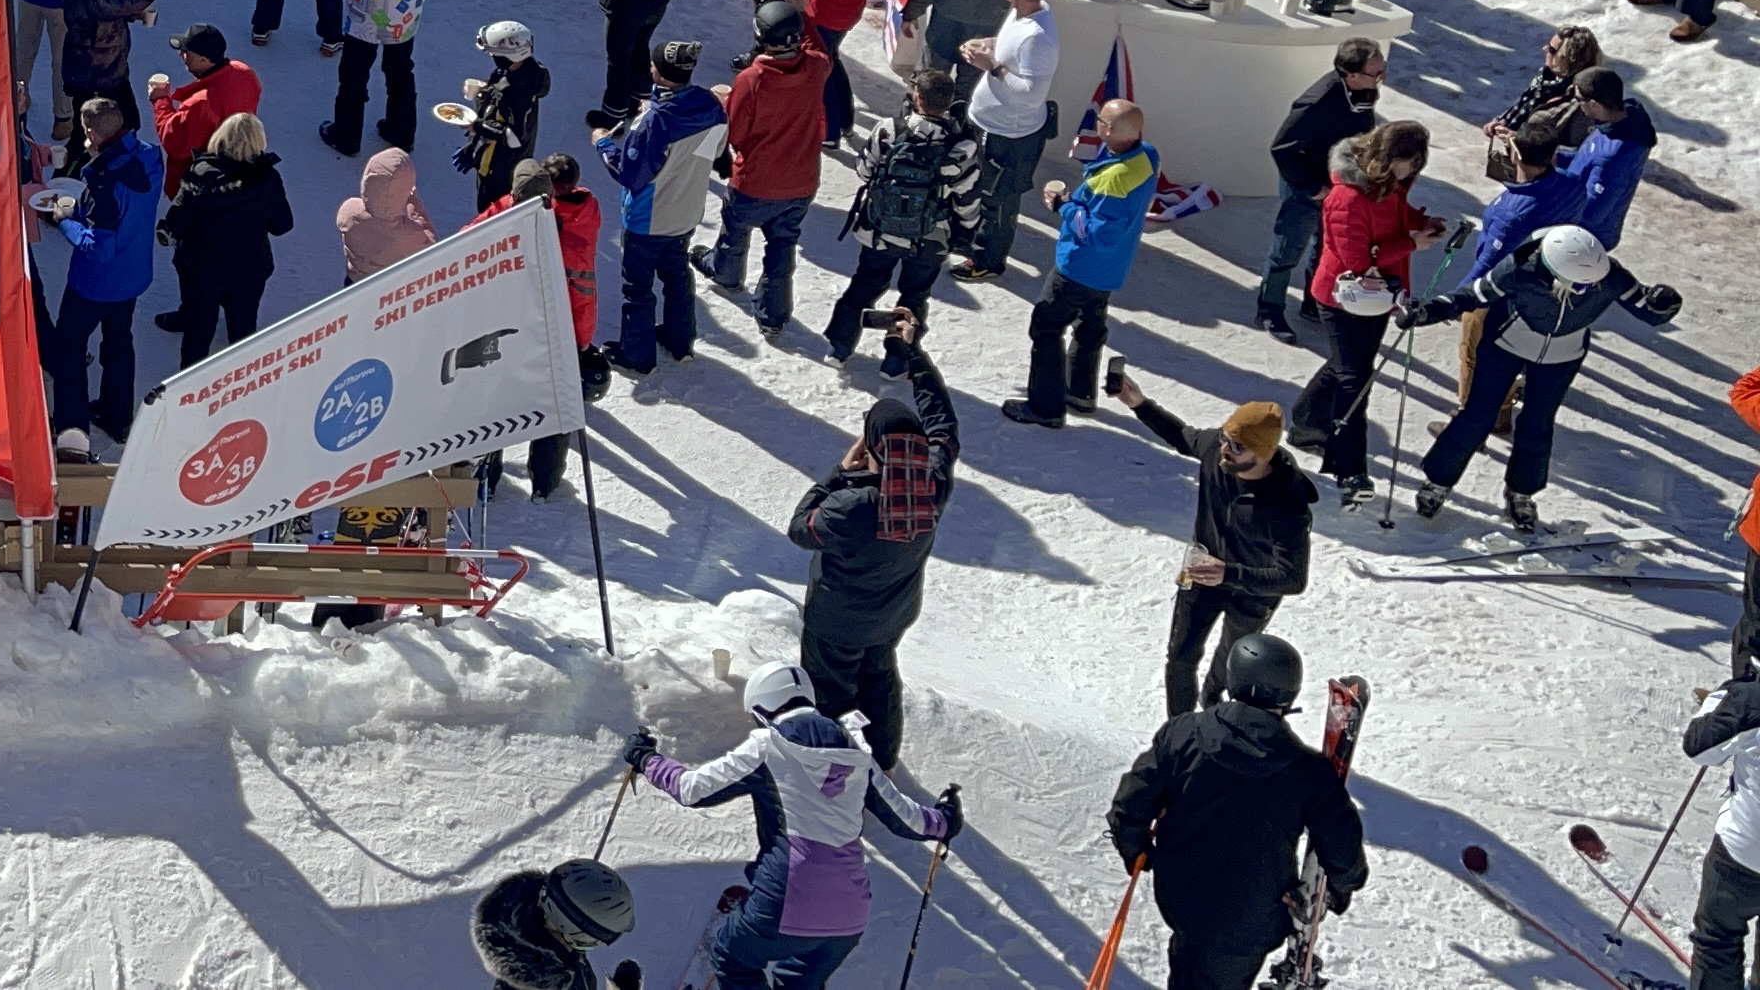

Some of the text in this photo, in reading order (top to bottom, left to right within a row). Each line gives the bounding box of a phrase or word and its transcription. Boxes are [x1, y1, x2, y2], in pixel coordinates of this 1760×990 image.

[374, 255, 526, 331] SKI DEPARTURE
[379, 234, 520, 310] MEETING POINT
[179, 314, 349, 406] RASSEMBLEMENT
[208, 347, 322, 417] DÉPART SKI
